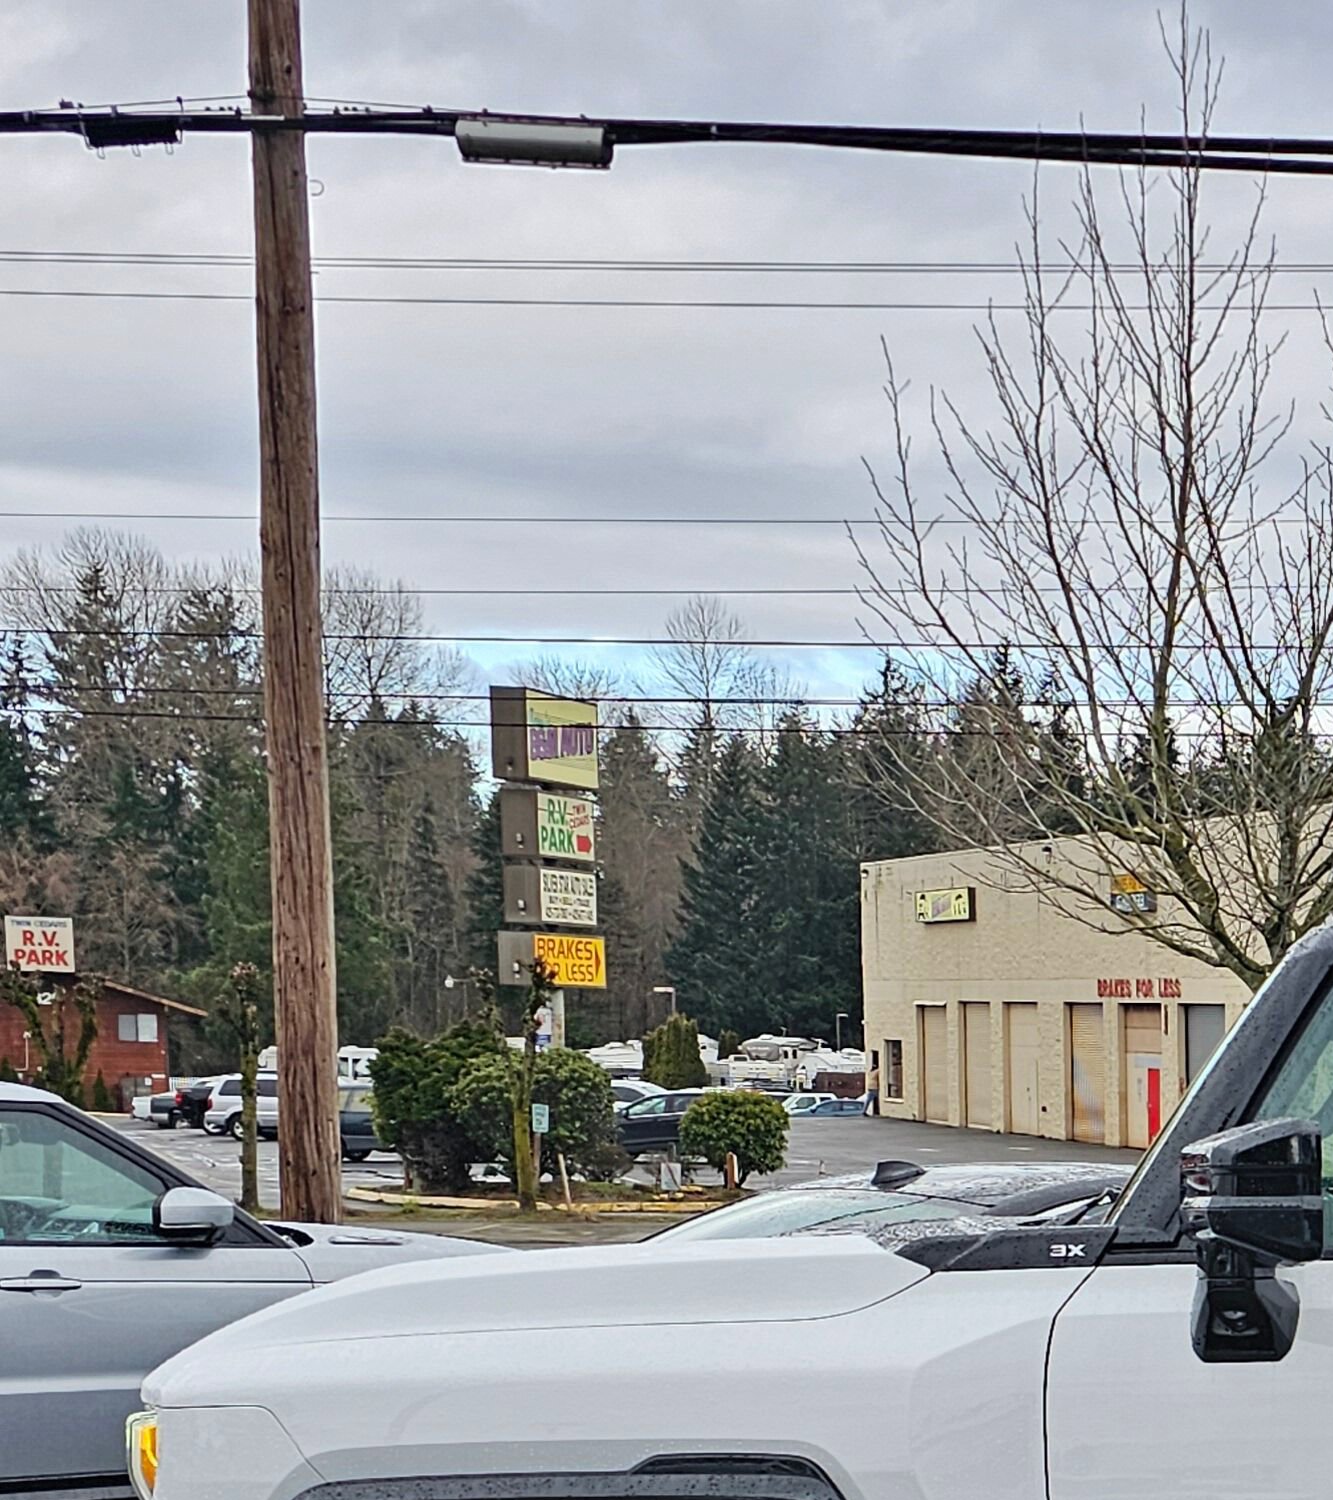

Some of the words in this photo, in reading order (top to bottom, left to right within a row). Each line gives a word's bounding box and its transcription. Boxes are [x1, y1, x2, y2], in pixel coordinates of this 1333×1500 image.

[541, 825, 575, 854] PARK
[22, 930, 60, 946] R.V.
[14, 949, 69, 966] PARK
[537, 938, 593, 960] BRAKES
[565, 963, 594, 982] LESS
[1097, 978, 1131, 998] BRAKES
[1136, 978, 1154, 998] FOR
[1158, 977, 1181, 998] LESS
[1050, 1244, 1086, 1257] 3X
